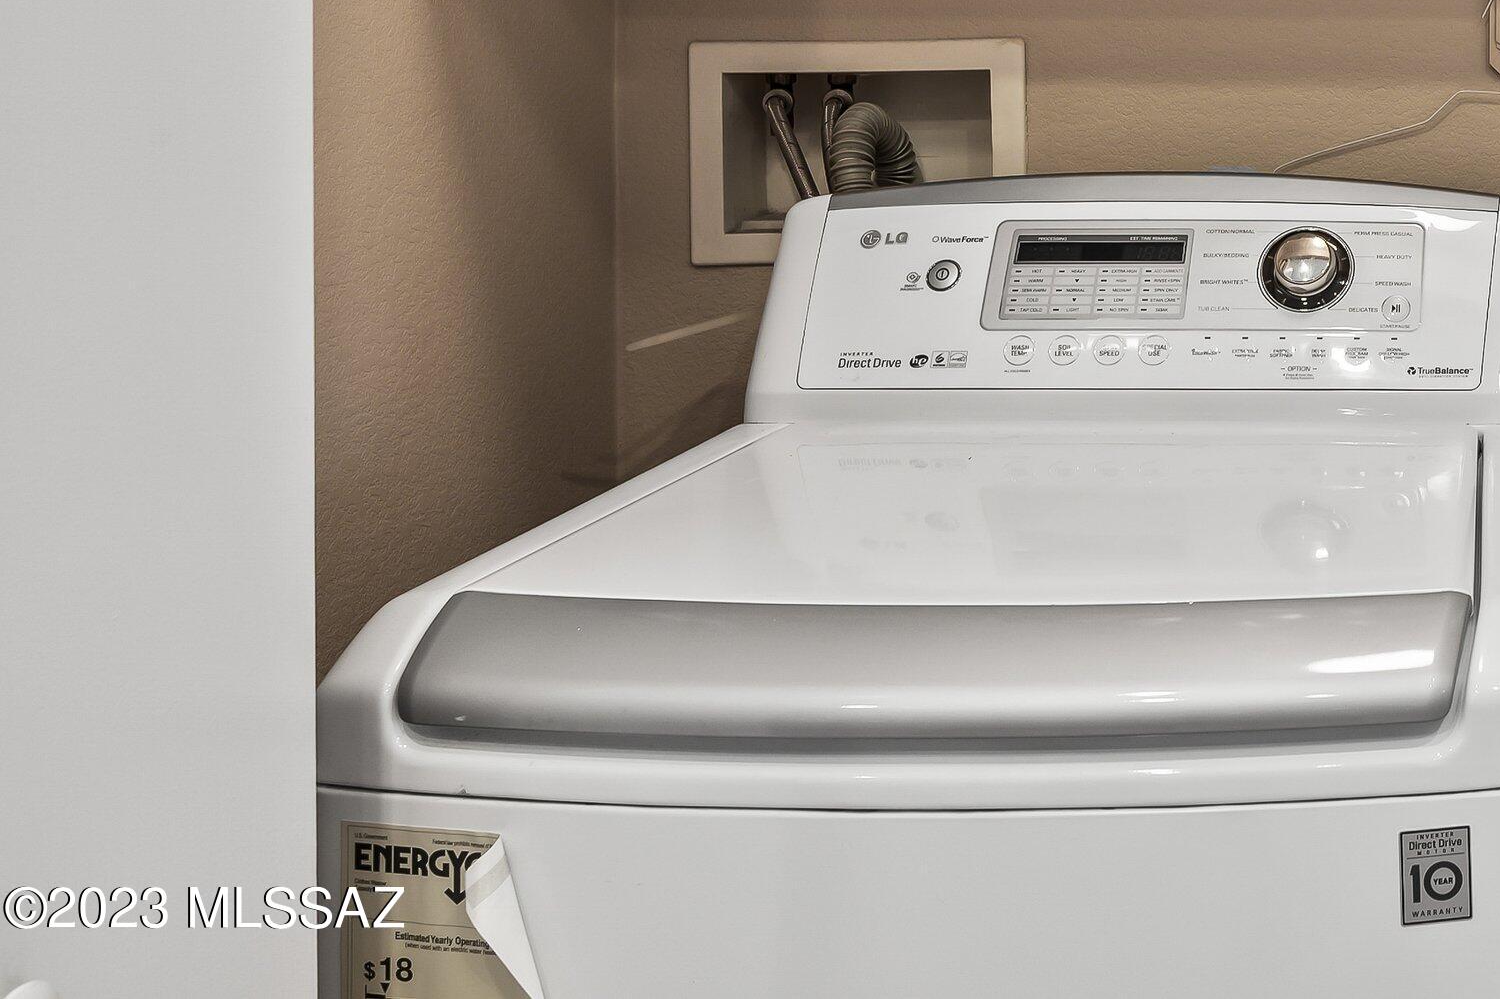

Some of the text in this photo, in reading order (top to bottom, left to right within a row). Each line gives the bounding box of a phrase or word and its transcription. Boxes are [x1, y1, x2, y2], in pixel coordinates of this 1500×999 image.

[884, 231, 909, 245] LG
[837, 358, 902, 369] Direct Drive
[1416, 831, 1454, 840] INVERTER
[1408, 838, 1462, 851] Direct Drive
[1417, 847, 1455, 856] MOTOR
[1409, 860, 1463, 903] 10
[1433, 877, 1454, 886] YEAR
[1411, 906, 1464, 918] WARRANTY
[395, 931, 490, 950] Estimated Yearly Operating
[432, 944, 442, 952] with
